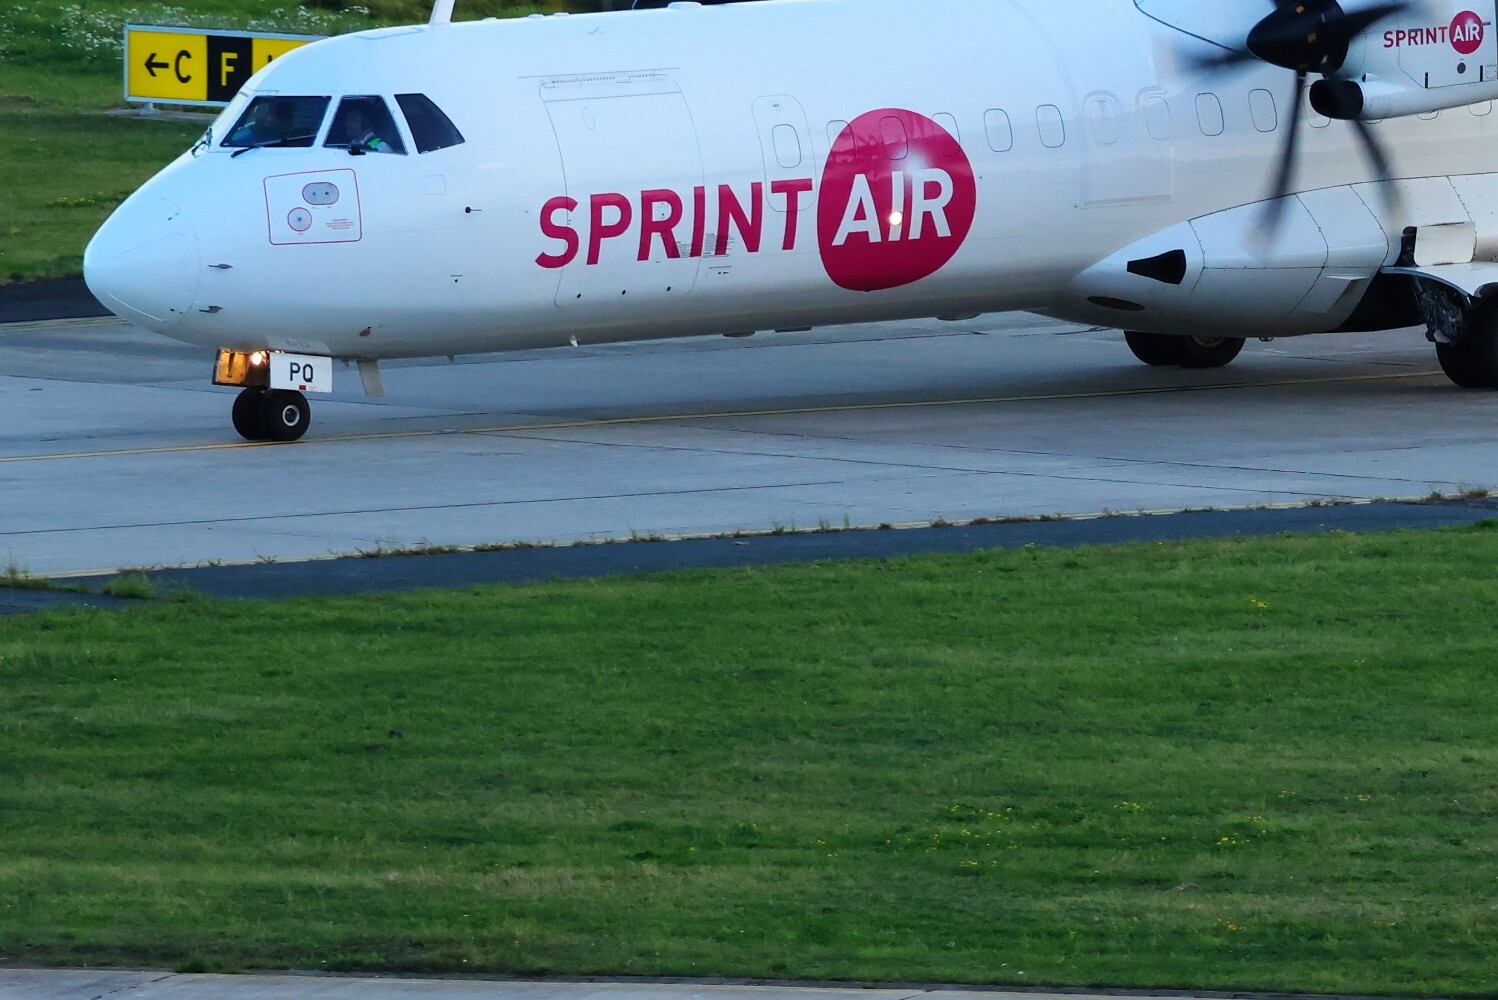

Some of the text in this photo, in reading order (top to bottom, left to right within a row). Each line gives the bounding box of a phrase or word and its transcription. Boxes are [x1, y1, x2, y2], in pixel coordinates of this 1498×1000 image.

[1383, 21, 1481, 48] SPRINT AIR
[174, 49, 239, 87] C F
[535, 166, 955, 269] SPRINT AIR
[289, 361, 314, 383] PQ
